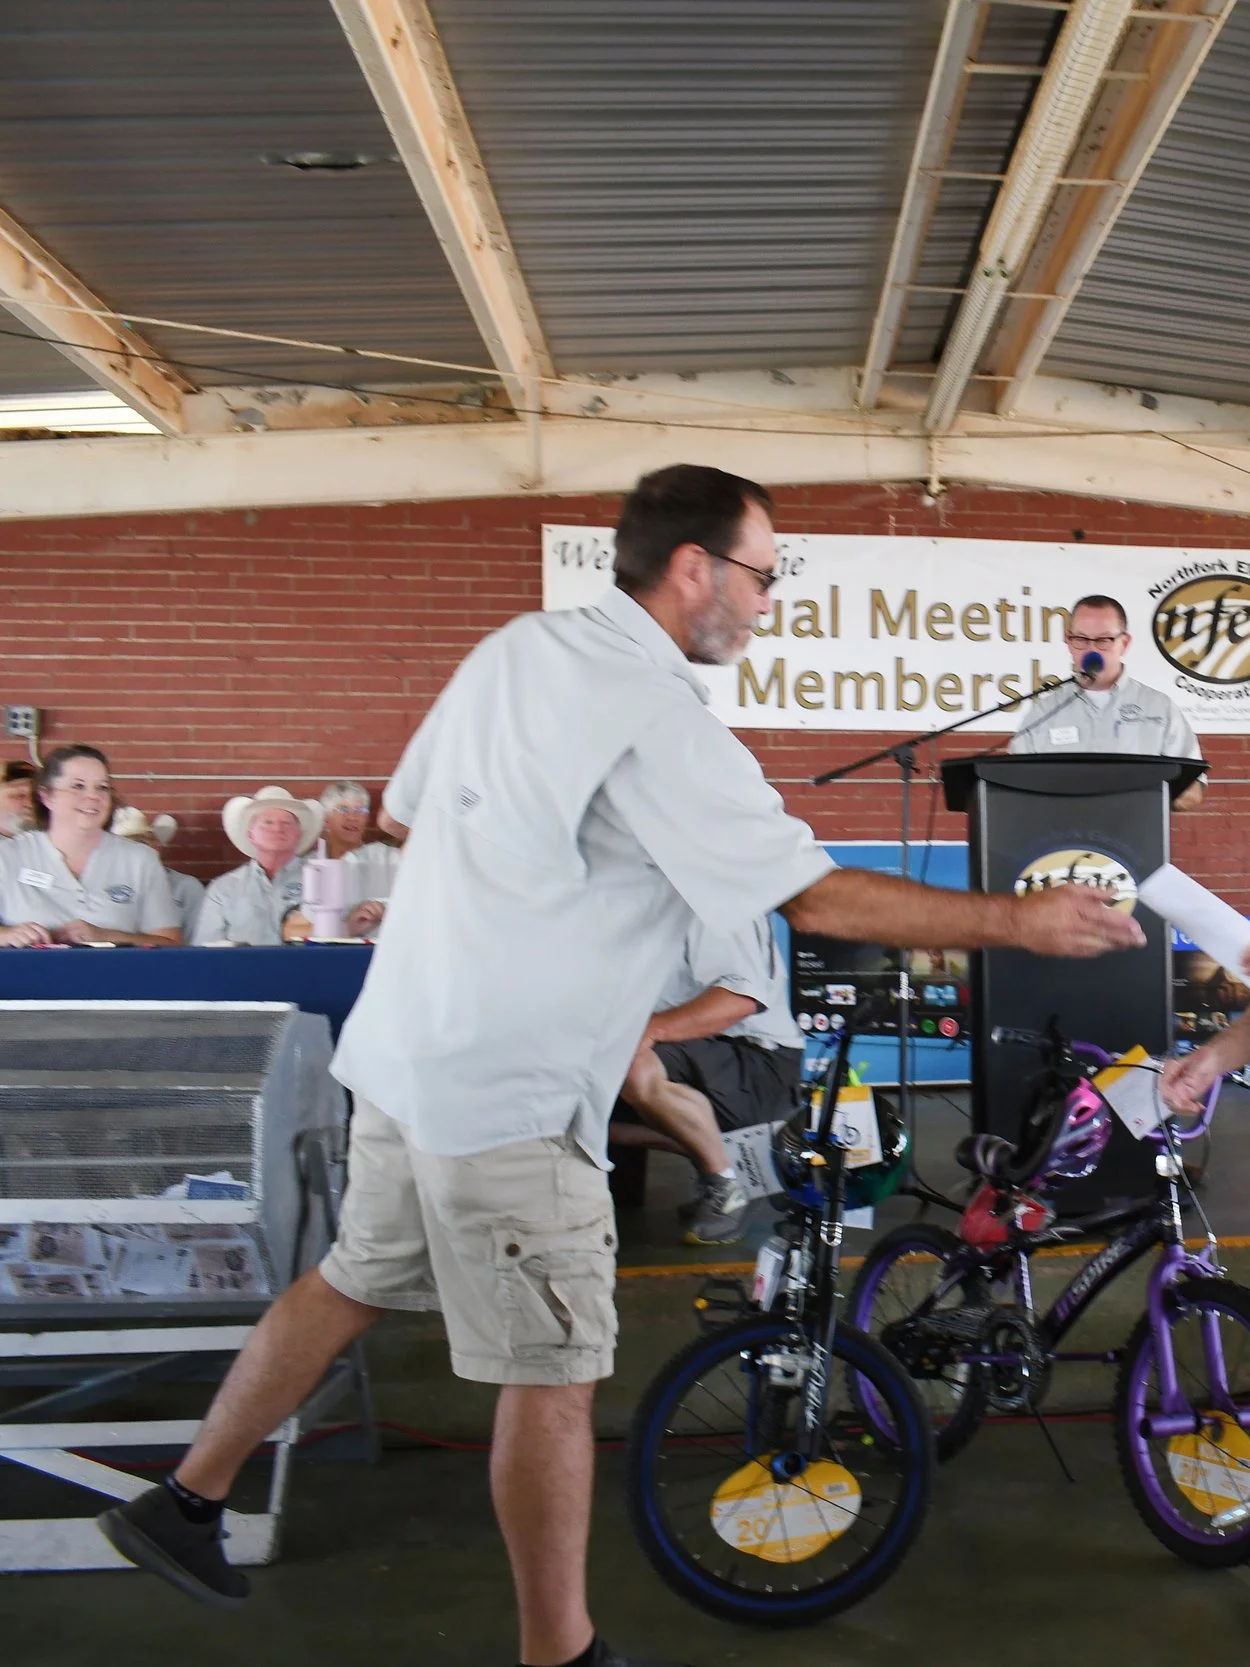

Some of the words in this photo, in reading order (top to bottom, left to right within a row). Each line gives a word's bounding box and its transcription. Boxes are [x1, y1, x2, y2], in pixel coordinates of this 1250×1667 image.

[1147, 558, 1230, 600] Northfork
[751, 585, 840, 638] ual
[869, 586, 1072, 642] Meetin
[738, 656, 1062, 713] Membersh
